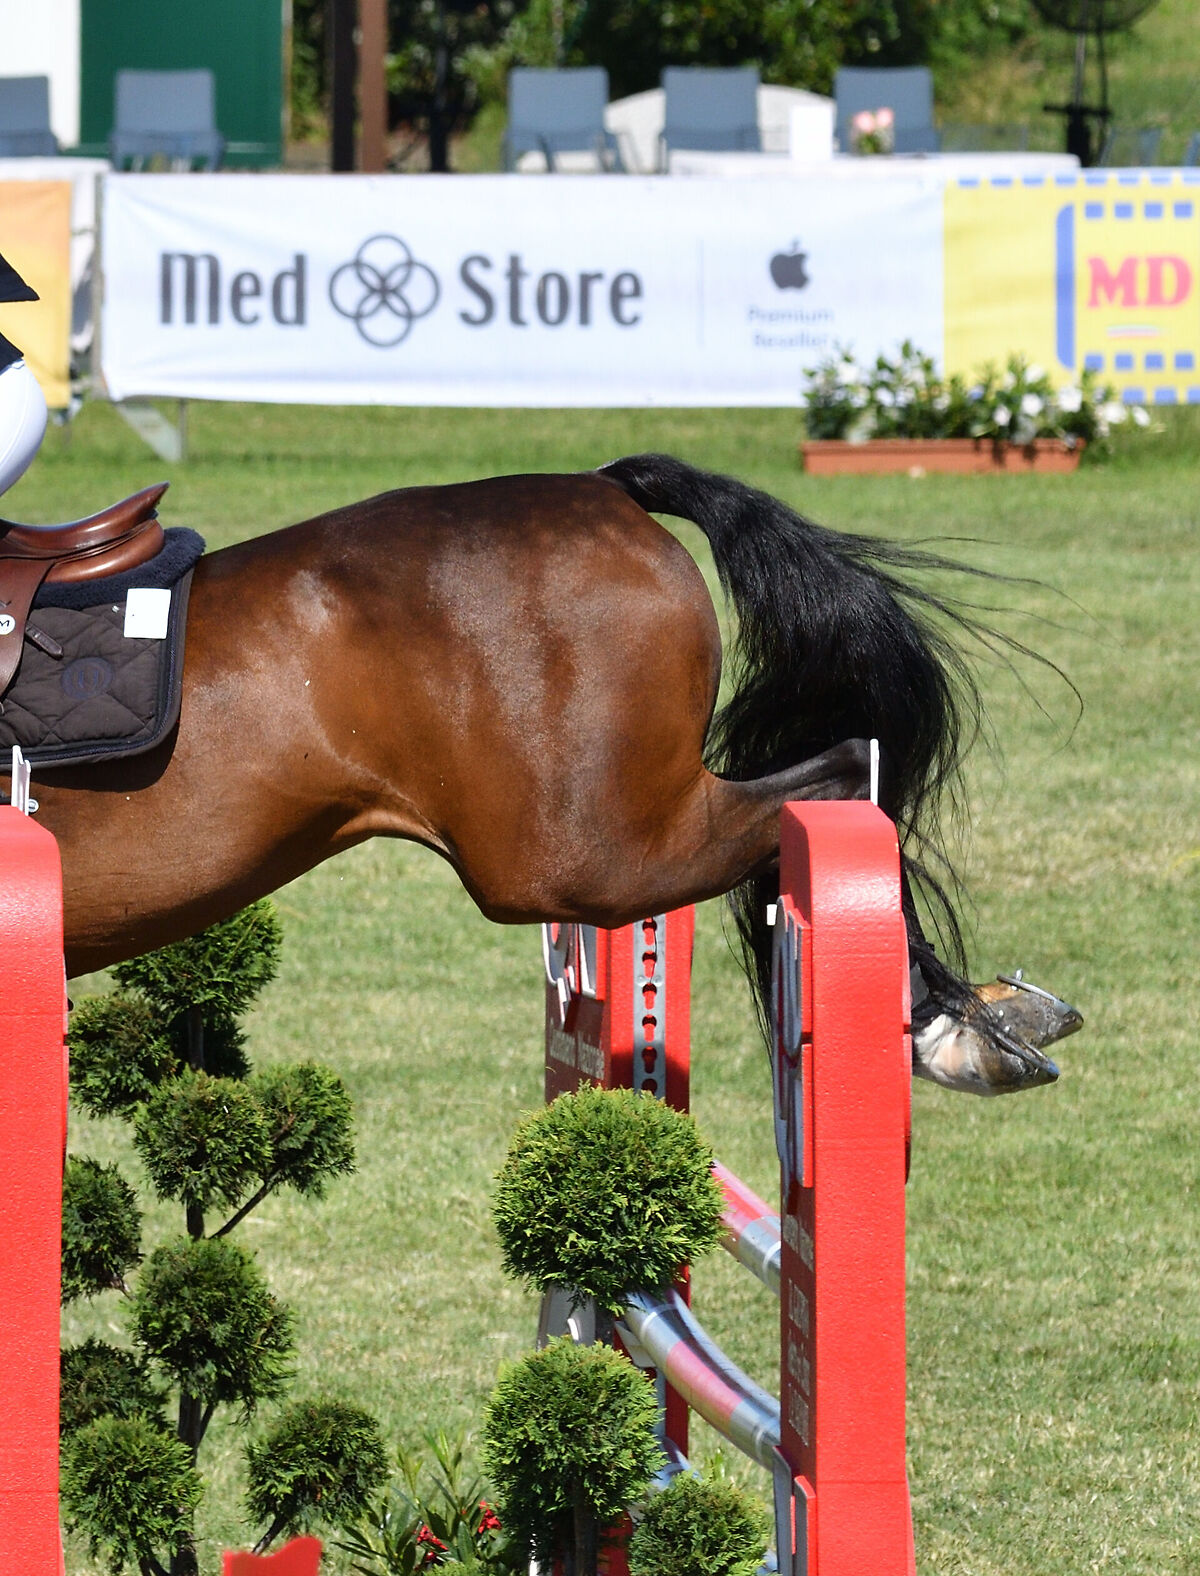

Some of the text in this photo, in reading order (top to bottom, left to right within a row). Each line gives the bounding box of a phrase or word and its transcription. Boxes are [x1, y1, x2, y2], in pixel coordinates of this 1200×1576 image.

[160, 252, 643, 327] Med Store
[1086, 256, 1194, 307] MD
